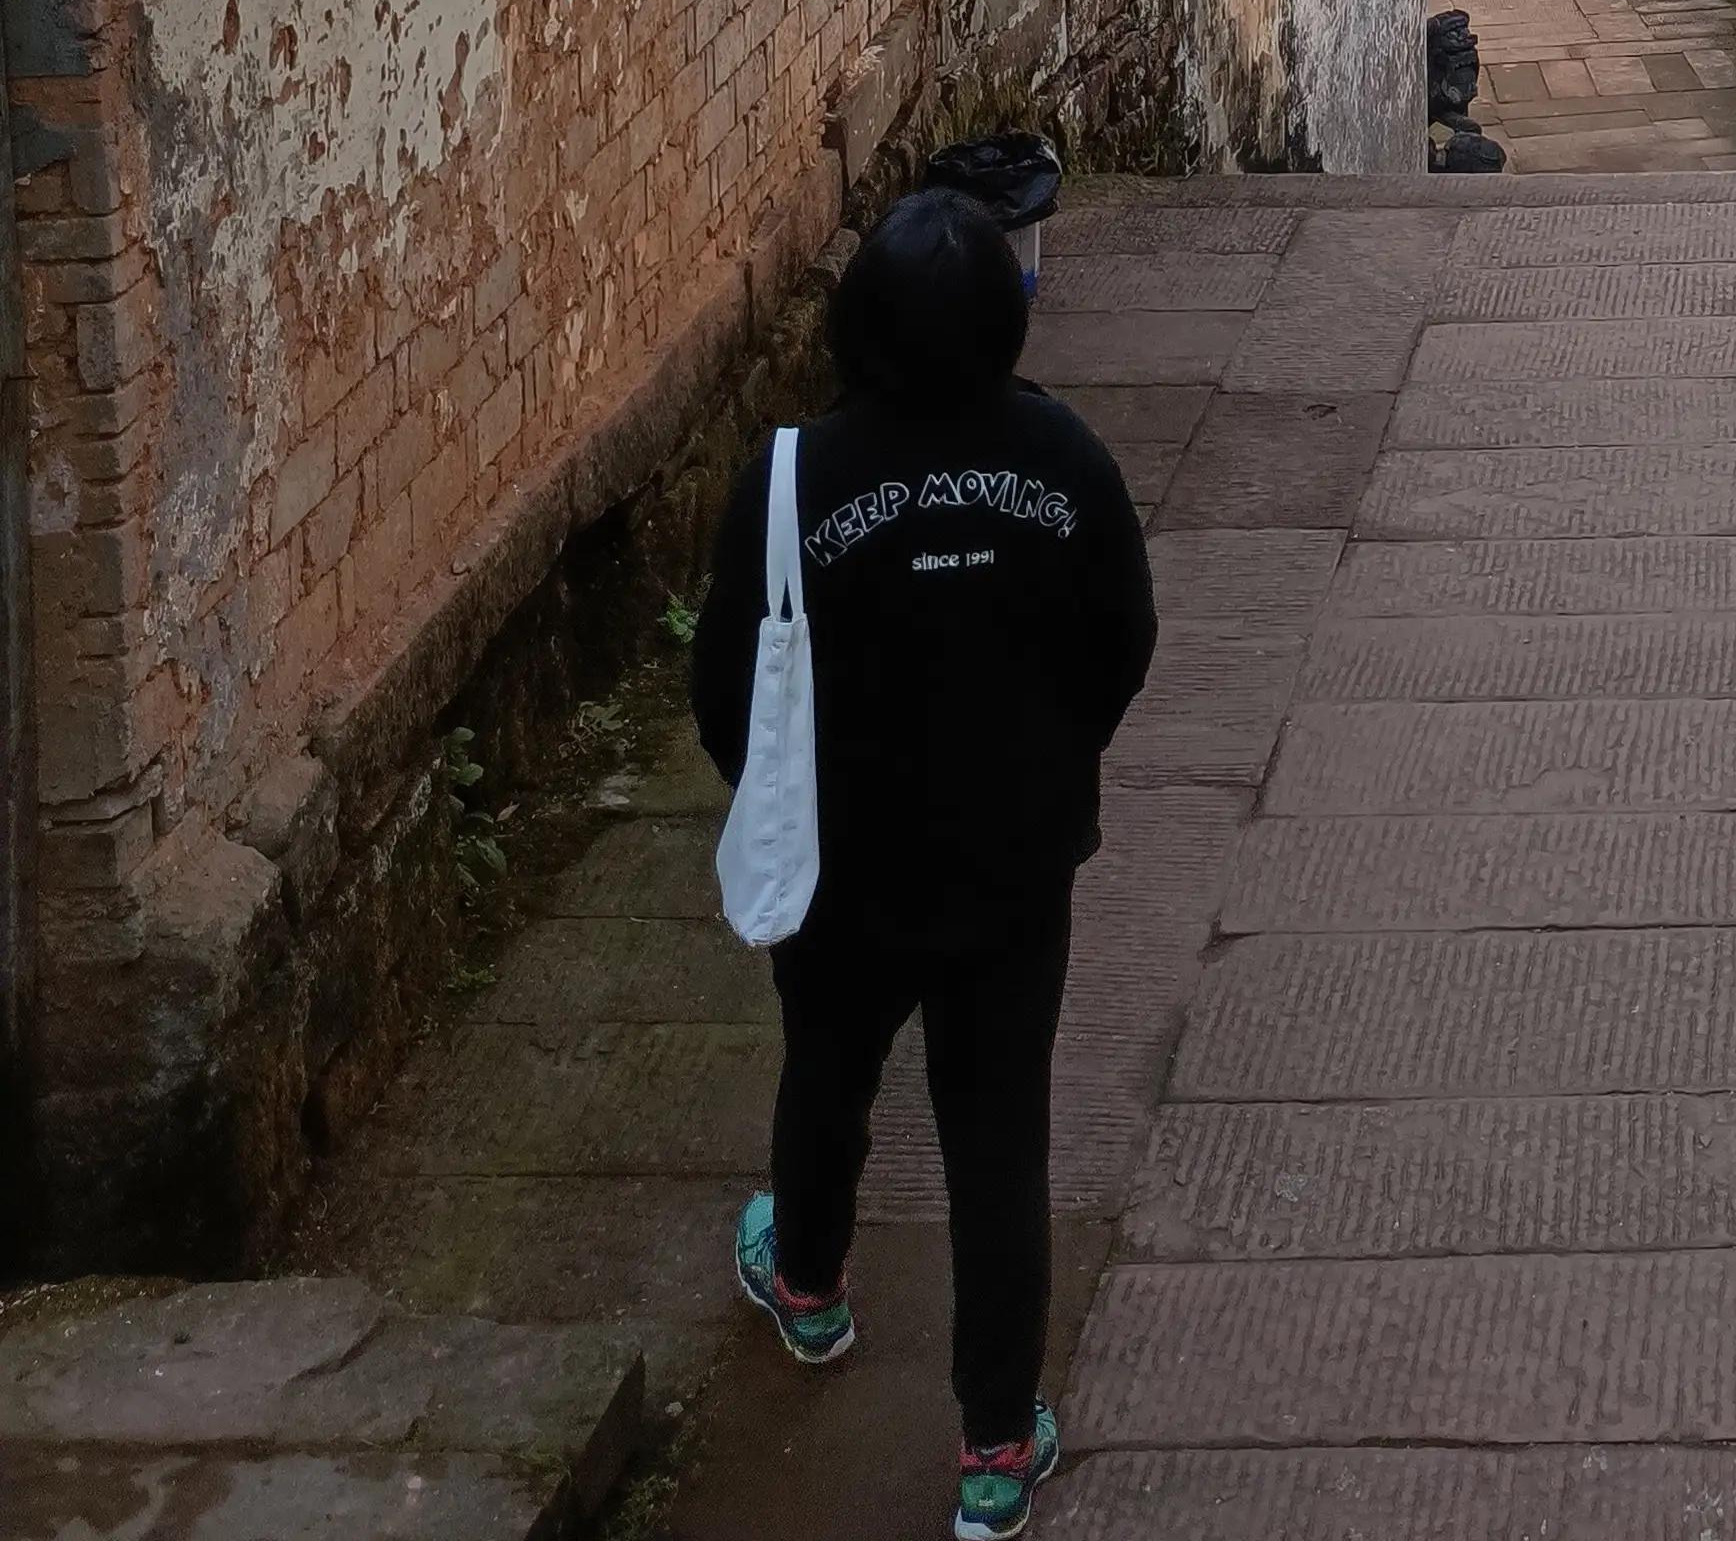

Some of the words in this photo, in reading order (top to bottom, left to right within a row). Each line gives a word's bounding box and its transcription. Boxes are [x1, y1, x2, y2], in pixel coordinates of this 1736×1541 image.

[804, 481, 911, 567] KEEP
[911, 551, 960, 571] since
[966, 548, 994, 566] 1991
